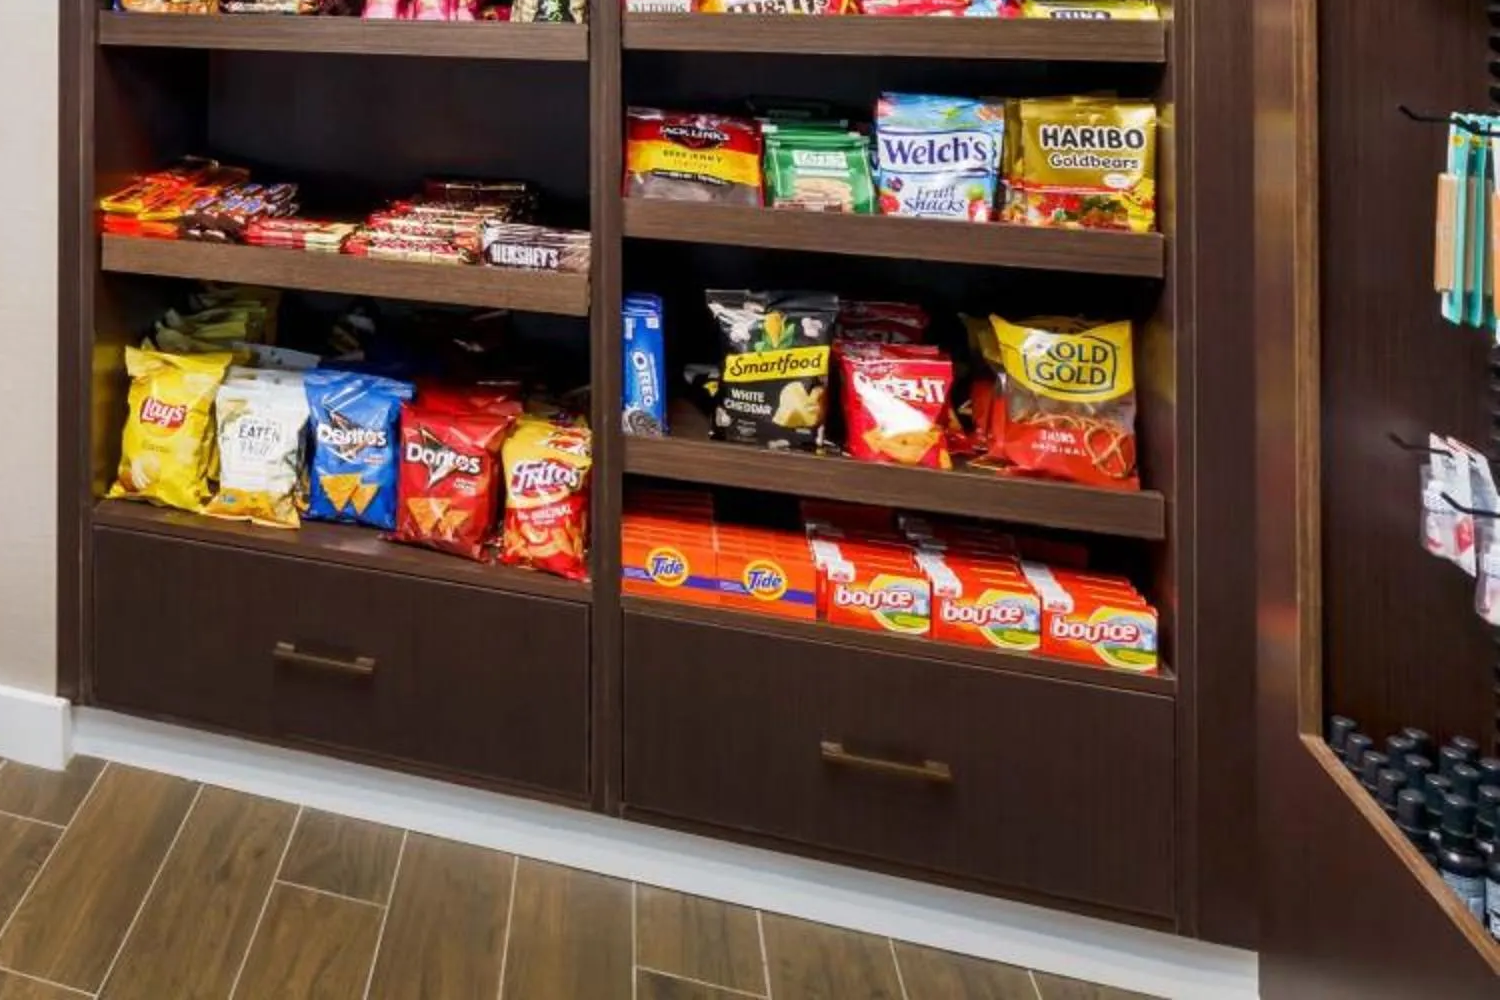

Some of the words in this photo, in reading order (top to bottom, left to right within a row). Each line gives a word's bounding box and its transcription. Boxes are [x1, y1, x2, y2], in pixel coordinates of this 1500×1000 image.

[1041, 127, 1145, 150] HARIBO
[883, 136, 988, 166] Welch's
[1050, 154, 1140, 170] Goldbears
[916, 186, 955, 201] Fruit
[904, 198, 965, 213] Snacks
[491, 244, 558, 268] HERSHEY'S
[729, 352, 823, 378] Smartfood
[1036, 362, 1108, 386] GOLD
[633, 351, 653, 407] OREO
[731, 389, 765, 402] WHITE
[723, 400, 773, 416] CHEDDAR
[239, 424, 281, 443] EATEN
[316, 423, 387, 447] Doritos
[406, 442, 481, 475] Doritos
[510, 461, 580, 495] Fritos
[651, 556, 684, 577] Tide
[748, 570, 782, 590] Tide
[836, 585, 913, 608] bounce
[942, 600, 1023, 624] bounce
[1052, 615, 1139, 642] bounce
